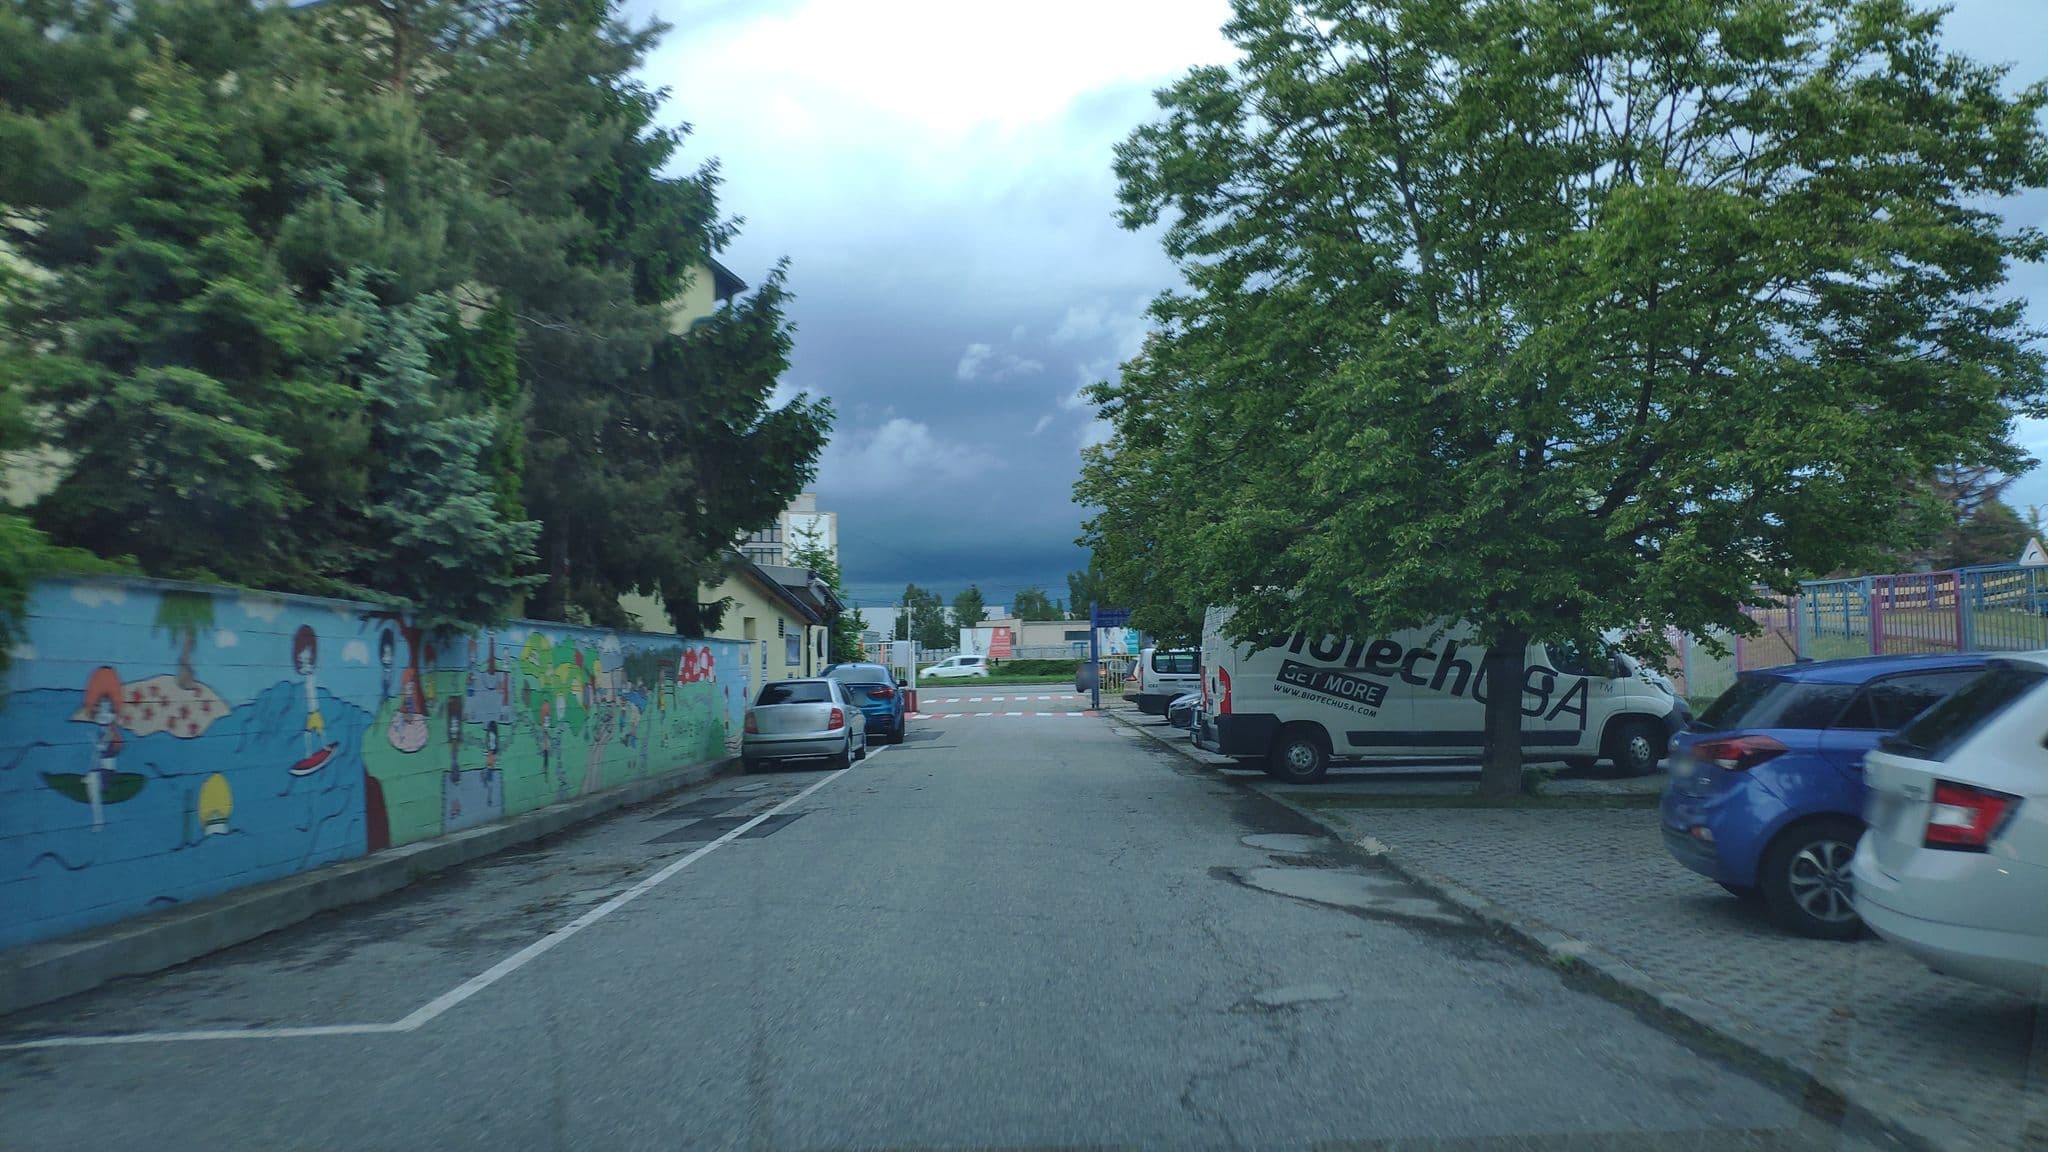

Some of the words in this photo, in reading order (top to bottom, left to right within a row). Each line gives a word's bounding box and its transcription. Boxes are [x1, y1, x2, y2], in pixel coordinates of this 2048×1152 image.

[1273, 684, 1378, 719] WWW.BIOTECHUSA.COM
[1284, 664, 1321, 689] GET
[1324, 673, 1382, 703] MORE
